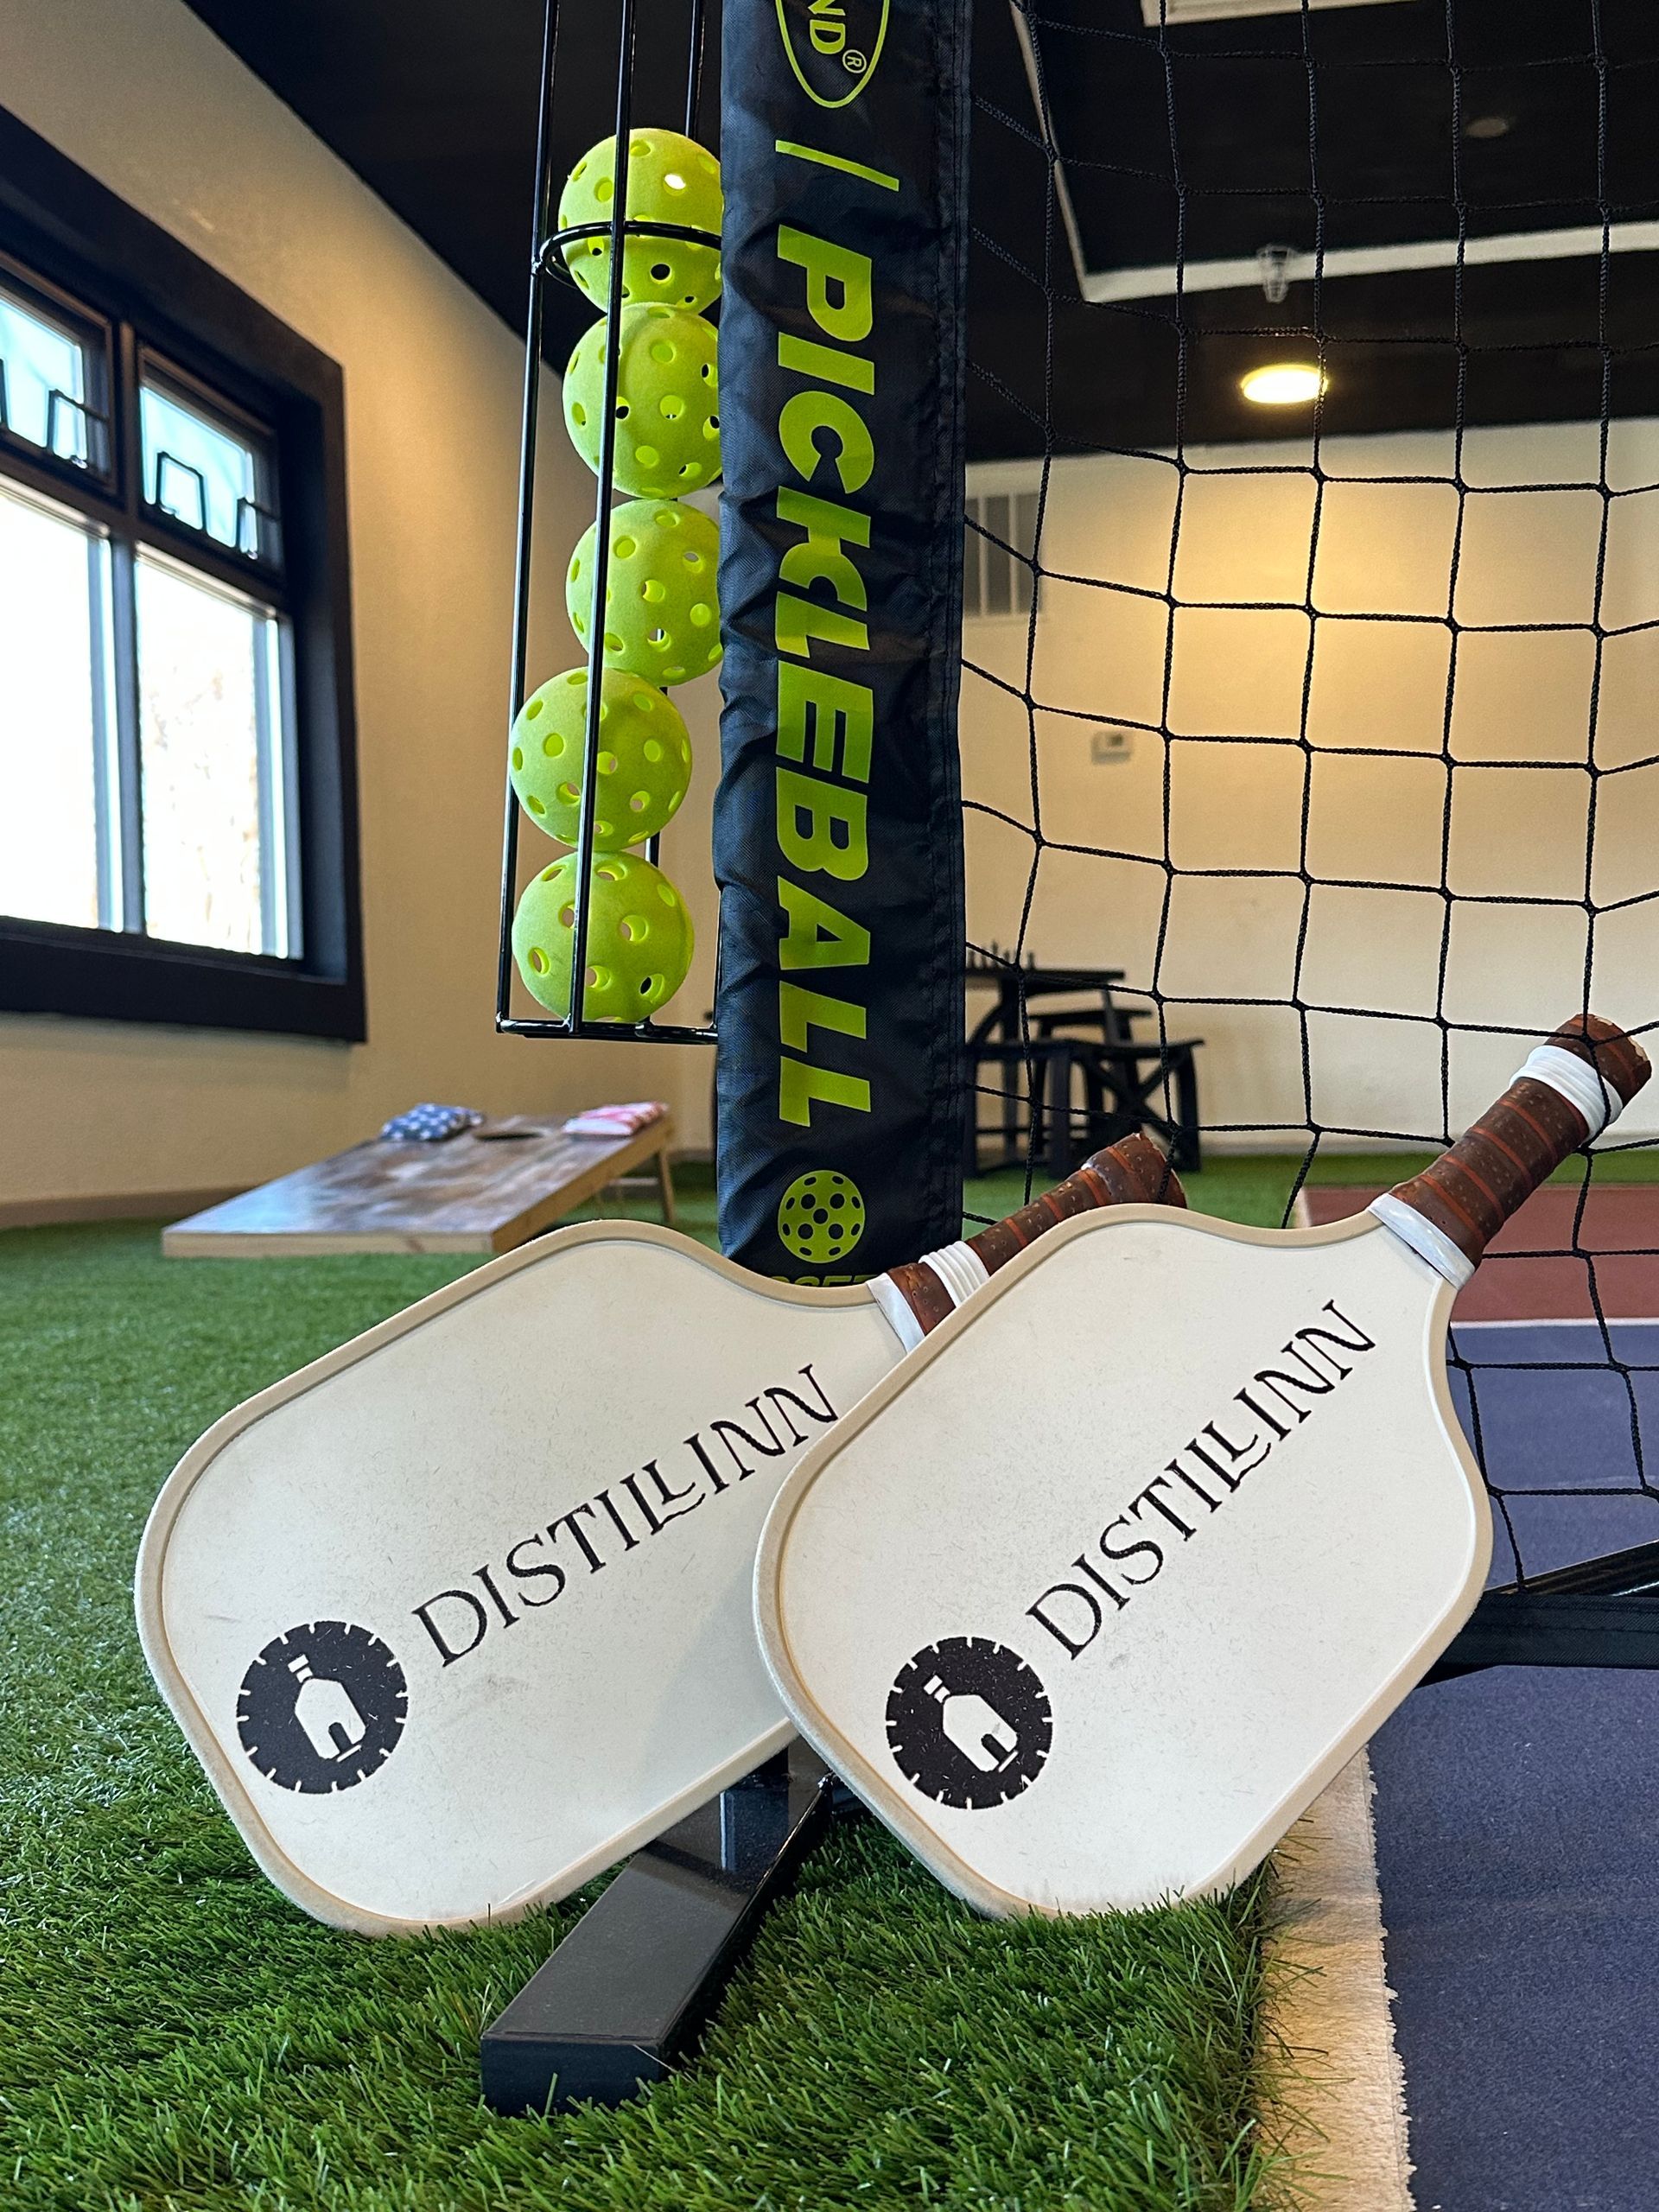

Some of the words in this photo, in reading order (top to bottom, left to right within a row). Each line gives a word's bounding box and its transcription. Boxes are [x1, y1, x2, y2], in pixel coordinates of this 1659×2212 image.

[776, 224, 876, 1127] PICKLEBALL
[411, 1363, 838, 1668] DISTILLINN
[1025, 1299, 1376, 1661] DISTILLINN
